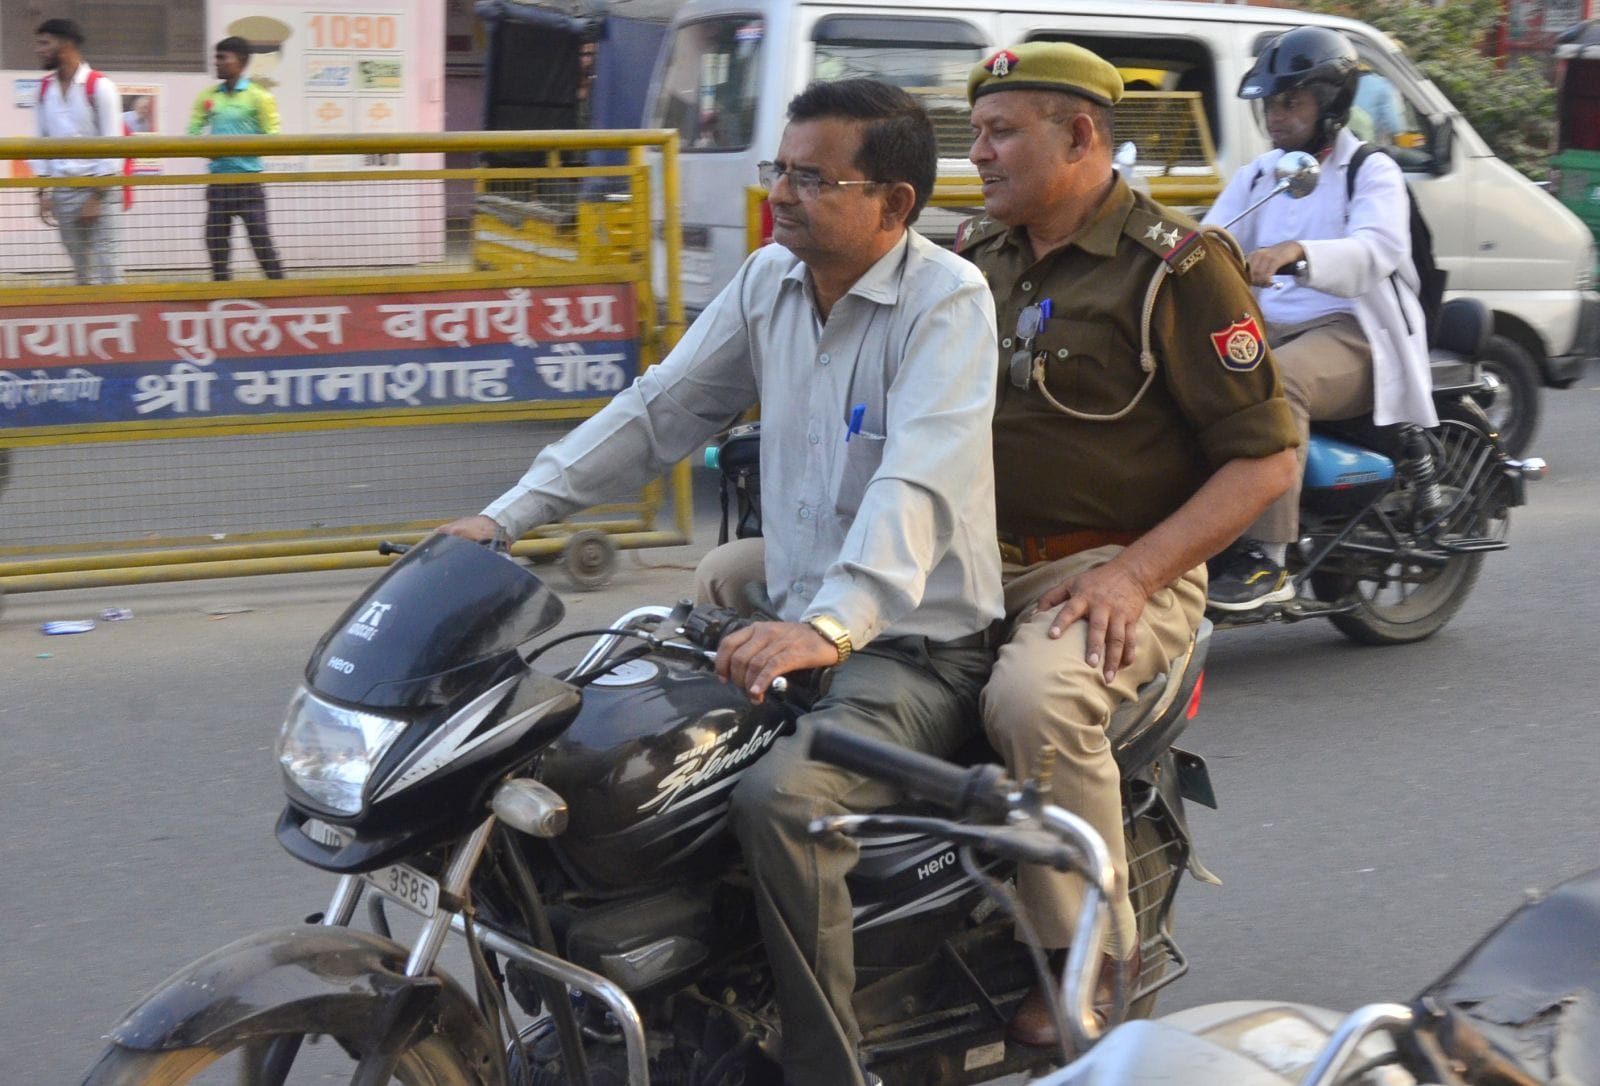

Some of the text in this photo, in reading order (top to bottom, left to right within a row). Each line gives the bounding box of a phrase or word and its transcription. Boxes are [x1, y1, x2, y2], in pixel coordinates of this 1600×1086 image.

[308, 15, 396, 48] 1090
[0, 314, 140, 360] ायात
[160, 299, 351, 366] पुलिस
[377, 288, 539, 348] बदायूँ
[132, 363, 218, 414] श्री
[232, 359, 515, 407] भामाशाह
[534, 342, 627, 393] चौक
[636, 720, 785, 814] Splendor
[389, 867, 430, 910] 3585
[917, 851, 956, 880] Hero
